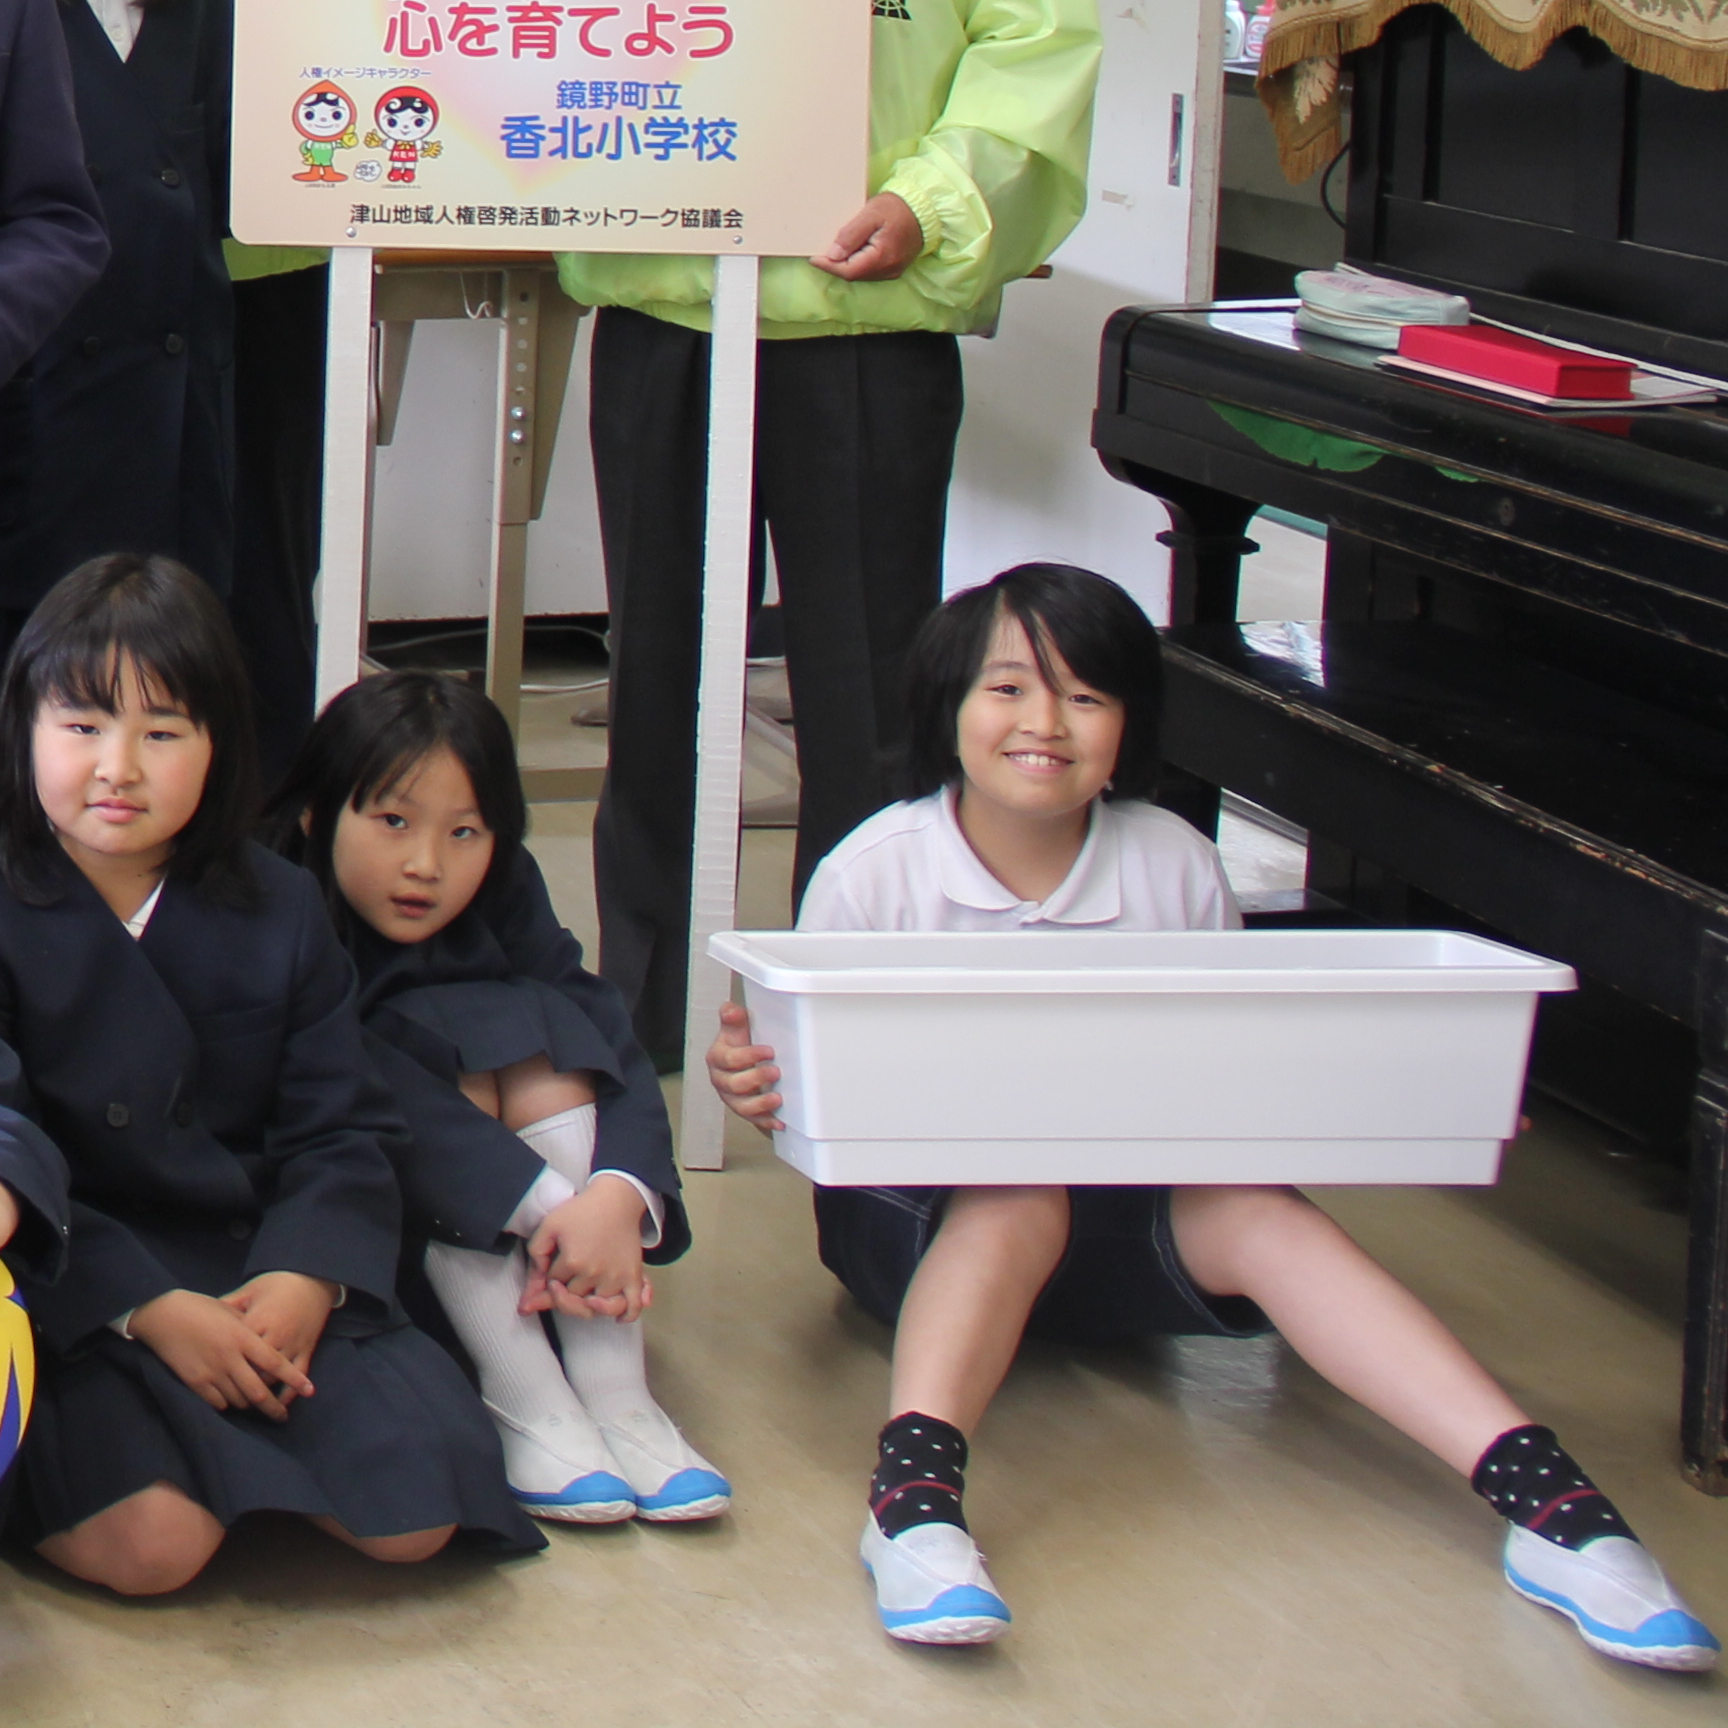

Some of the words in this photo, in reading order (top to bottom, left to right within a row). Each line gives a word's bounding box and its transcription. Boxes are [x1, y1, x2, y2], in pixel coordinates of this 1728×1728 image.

[382, 0, 735, 60] 心を育てよう
[299, 66, 432, 80] 人権イメージキャラクター
[556, 80, 683, 111] 鏡野町立
[500, 114, 738, 162] 香北小学校
[348, 204, 745, 229] 津山地域人権啓発活動ネットワーク協議会
